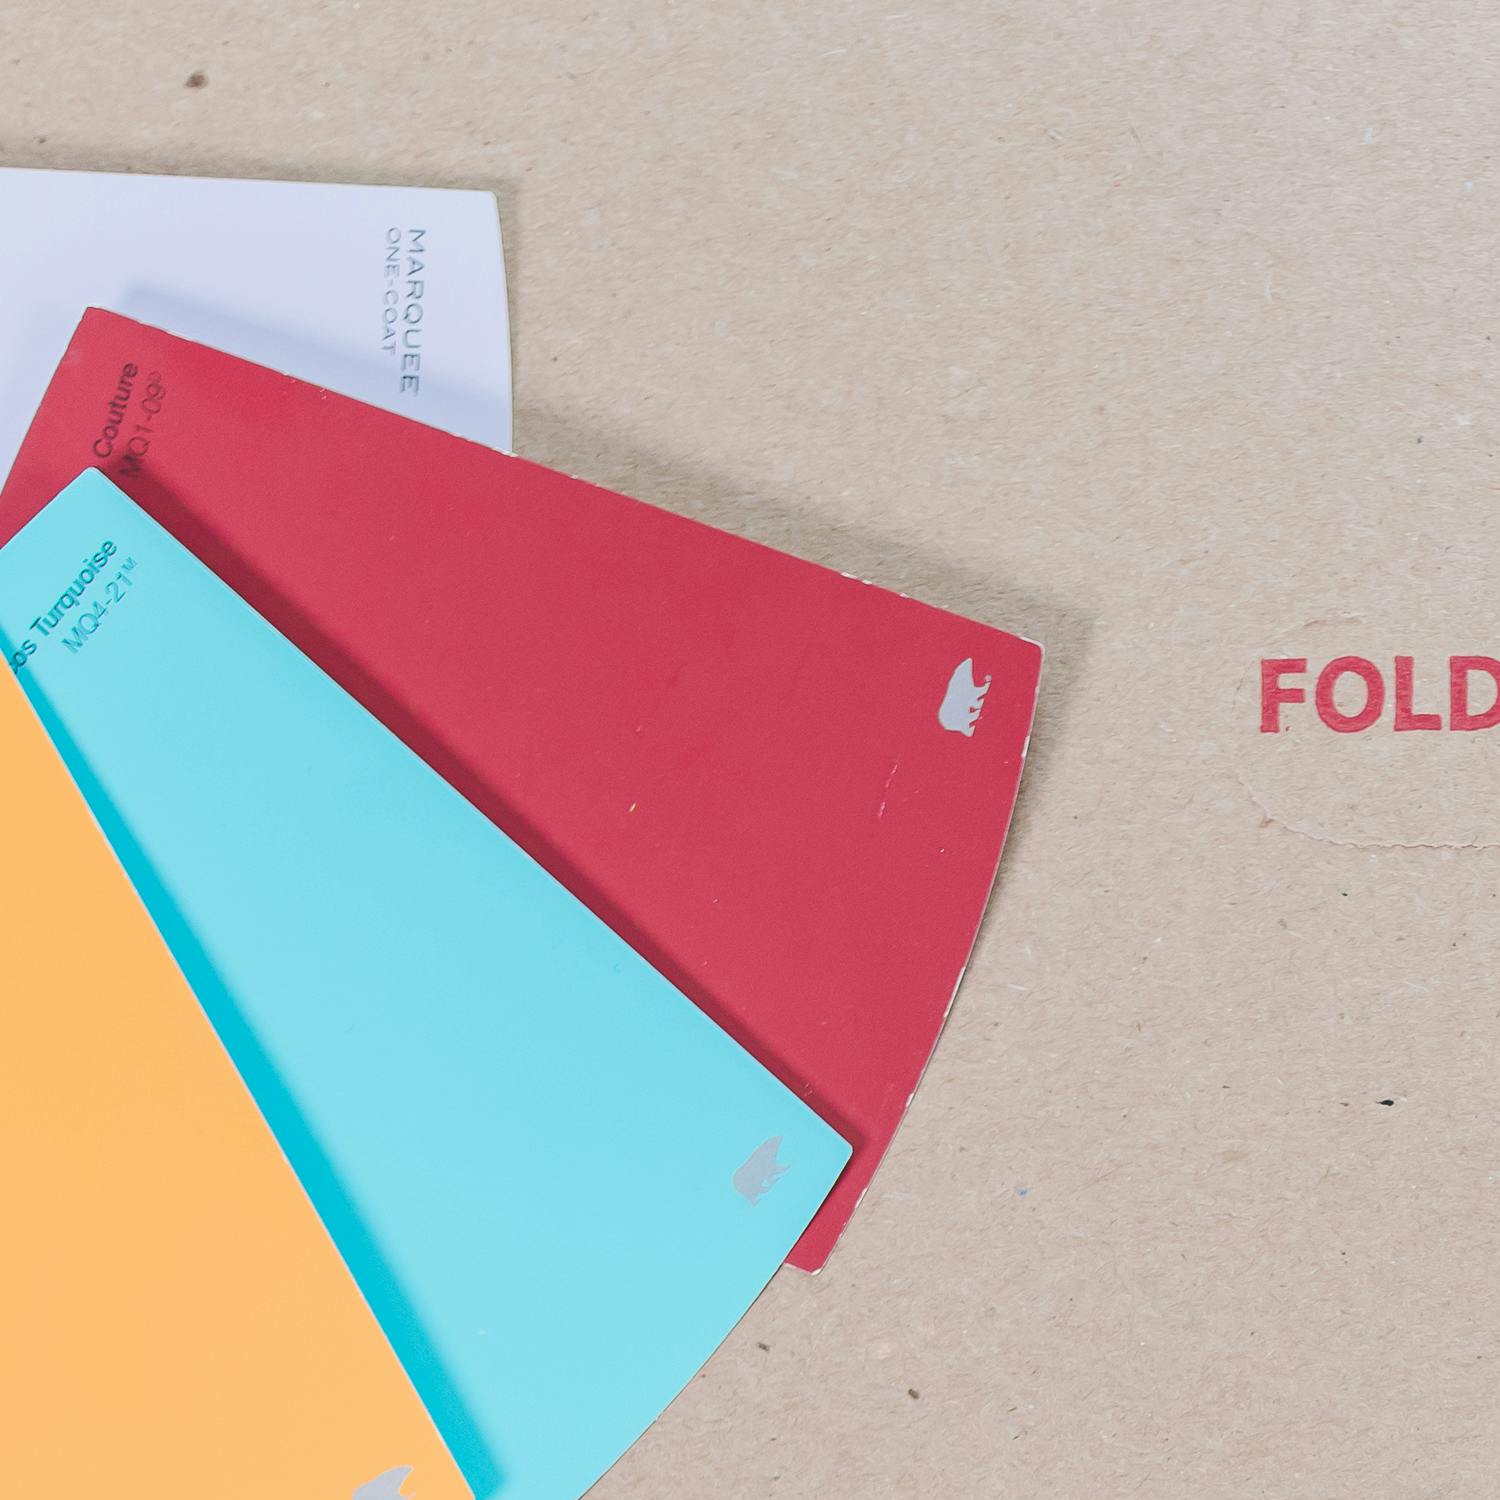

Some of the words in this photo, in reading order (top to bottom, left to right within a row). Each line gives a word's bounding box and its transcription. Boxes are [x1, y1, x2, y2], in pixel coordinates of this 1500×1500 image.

[381, 226, 402, 356] ONE-COAT
[399, 228, 427, 396] MARQUEE
[93, 362, 139, 459] Couture
[9, 639, 37, 675] os
[29, 540, 118, 637] Turquoise
